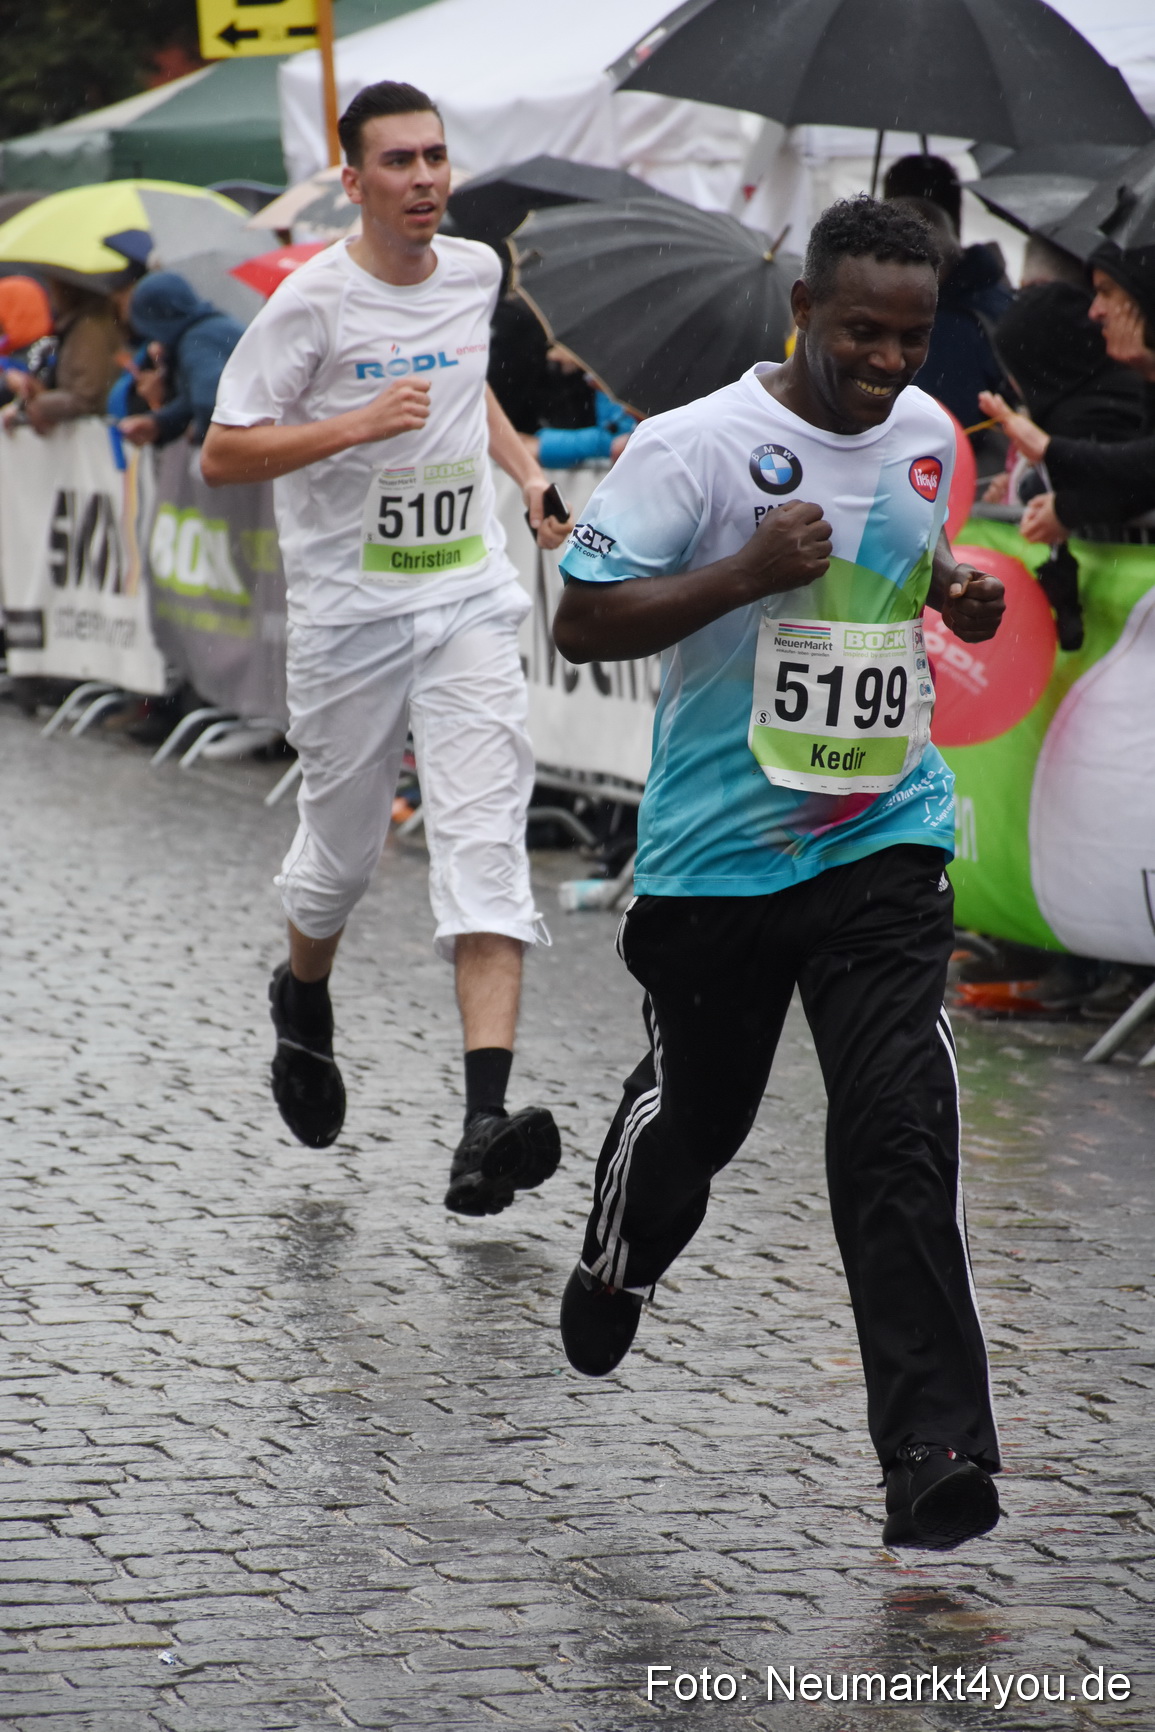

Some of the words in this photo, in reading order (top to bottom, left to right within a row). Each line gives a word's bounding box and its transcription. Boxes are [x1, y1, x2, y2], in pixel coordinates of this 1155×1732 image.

[751, 445, 795, 462] BMW
[424, 459, 474, 480] BOCK
[378, 484, 474, 539] 5107
[391, 549, 462, 569] Christian
[774, 637, 833, 651] NeuerMarkt
[843, 629, 906, 651] BOCK
[775, 661, 907, 730] 5199
[811, 743, 866, 771] Kedir
